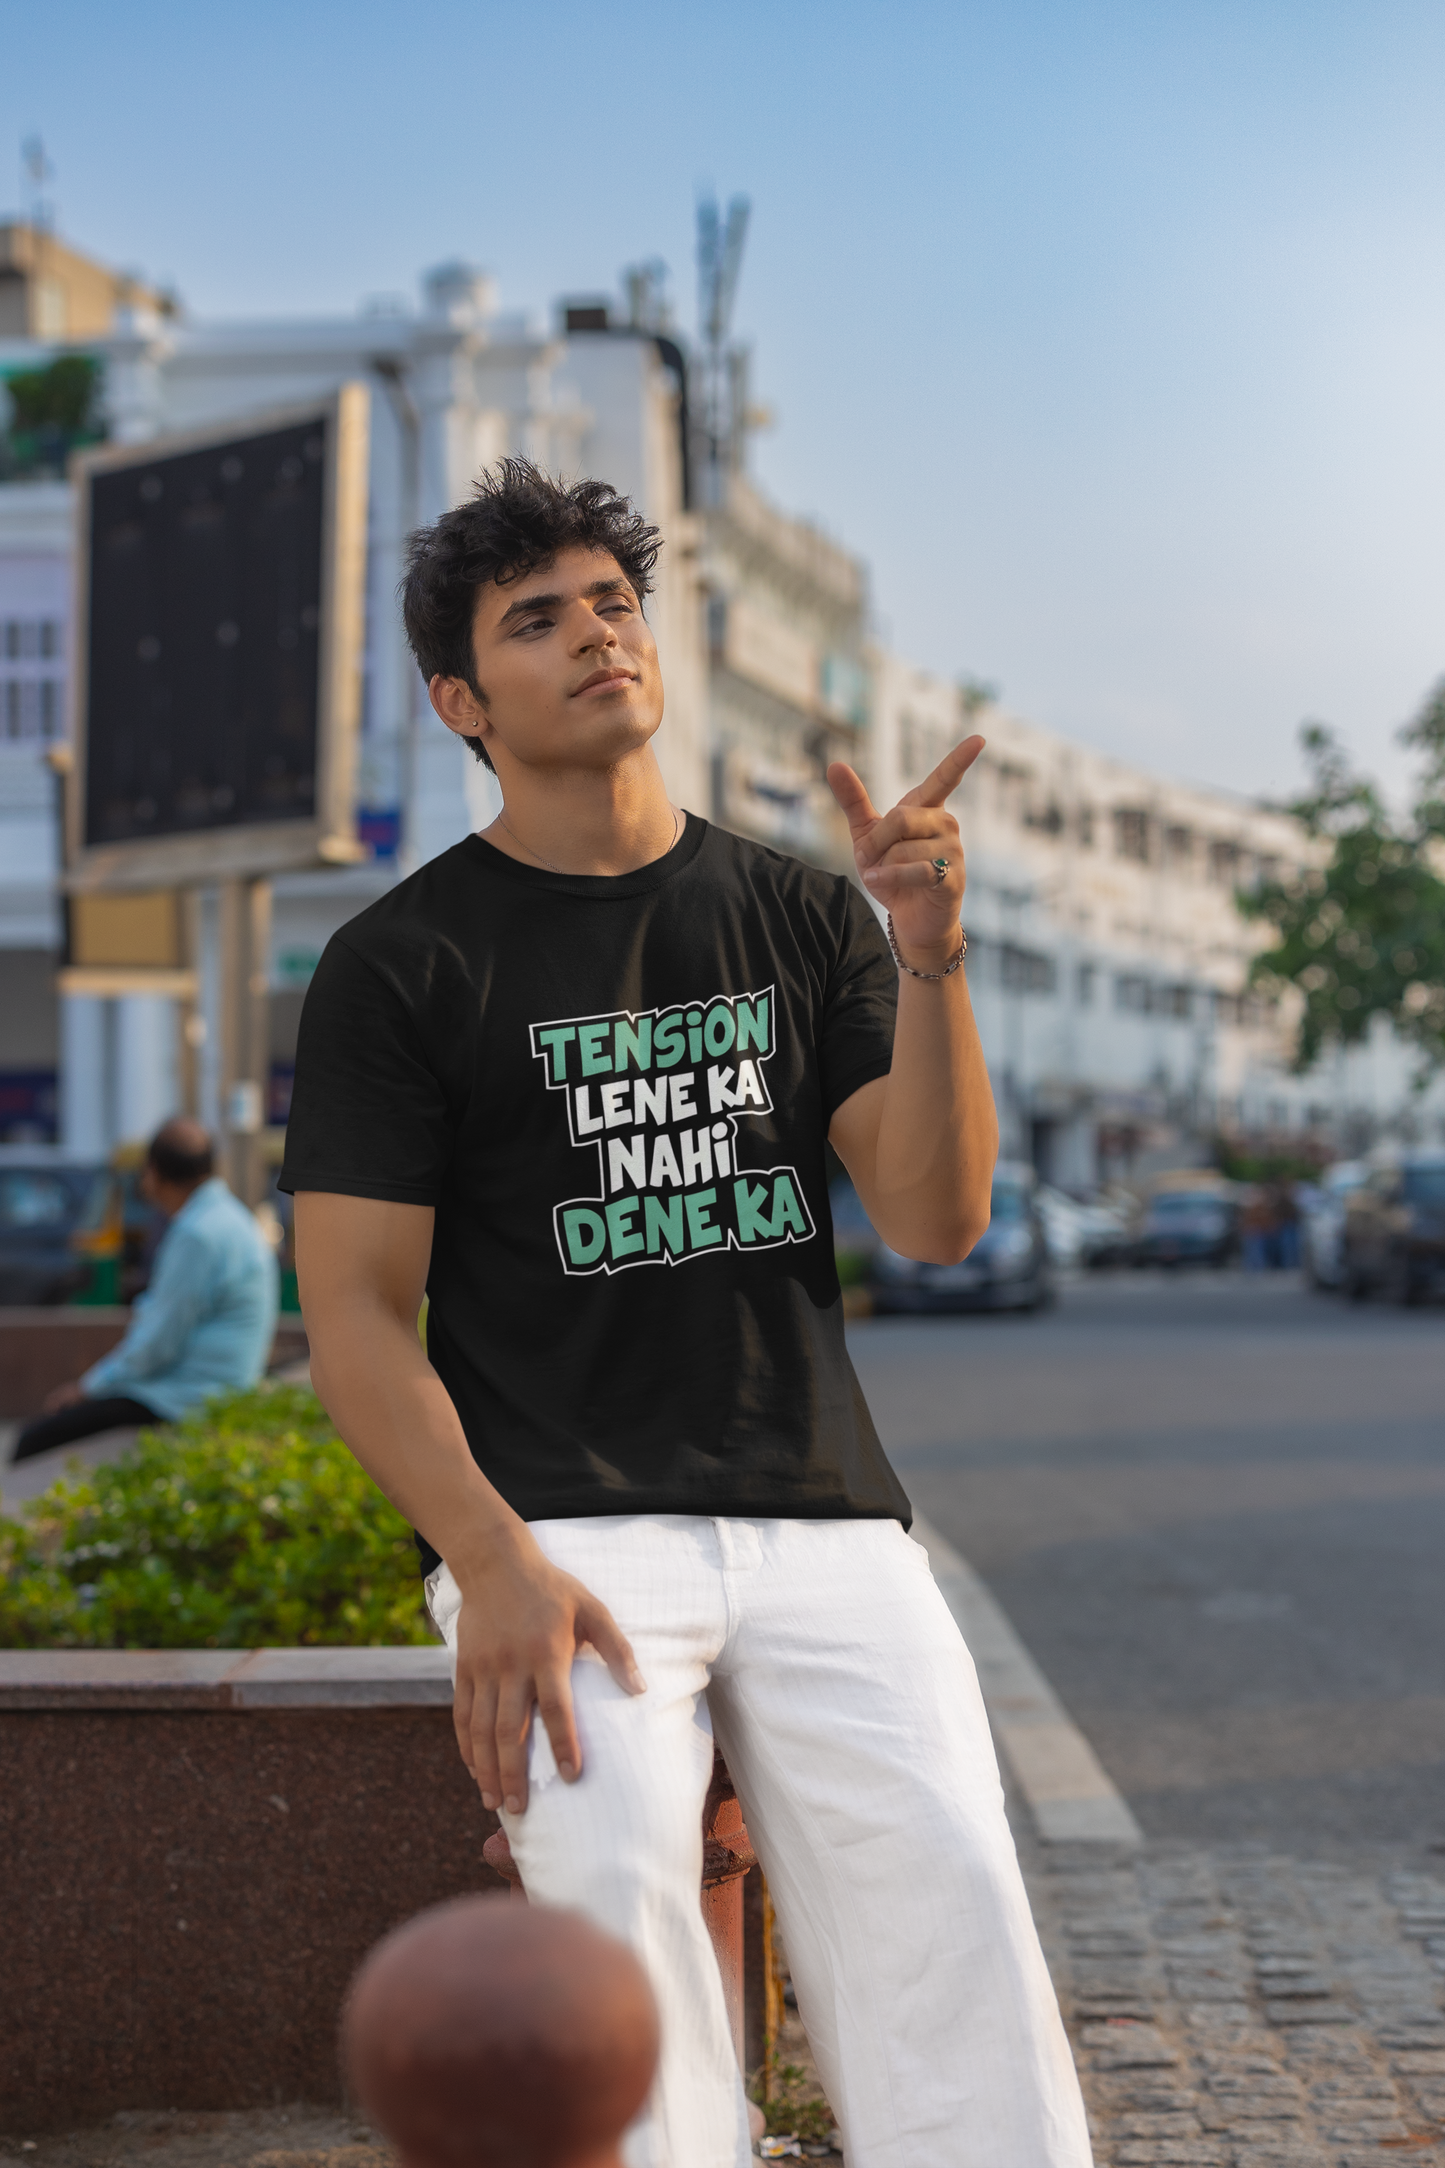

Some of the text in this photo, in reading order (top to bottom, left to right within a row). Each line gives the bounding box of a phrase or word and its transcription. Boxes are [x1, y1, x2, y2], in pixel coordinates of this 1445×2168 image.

[575, 1059, 765, 1136] LENE KA
[562, 1175, 807, 1265] DENE KA
